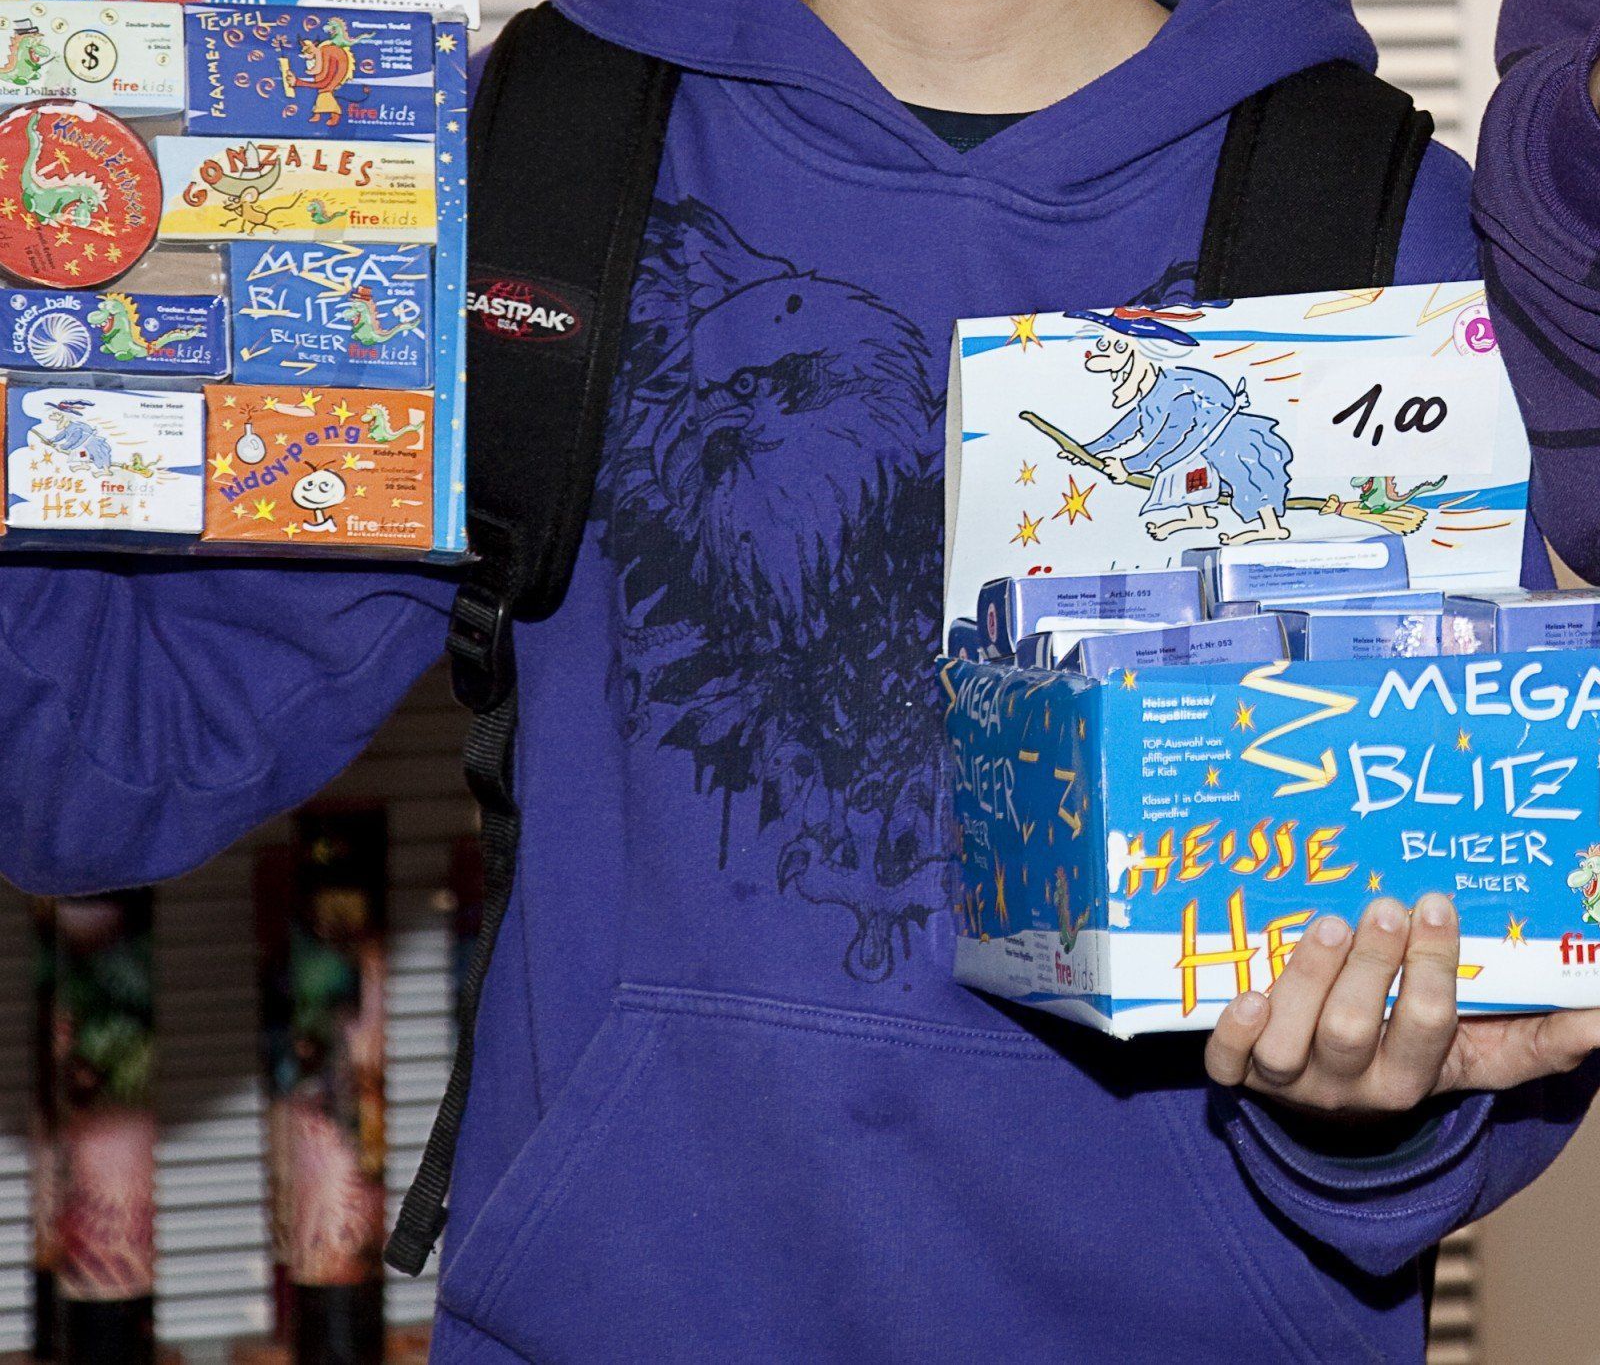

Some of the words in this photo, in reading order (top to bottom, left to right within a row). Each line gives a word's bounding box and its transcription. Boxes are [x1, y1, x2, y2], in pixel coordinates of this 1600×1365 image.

[196, 11, 277, 31] TEUFEL
[205, 37, 227, 118] FLAMMEN
[182, 143, 373, 208] GONZALES
[253, 251, 390, 286] MEGA
[1332, 383, 1449, 447] 1,00
[30, 476, 88, 493] HEISSE
[41, 492, 119, 521] HEXE
[1217, 639, 1233, 647] 053
[1142, 697, 1178, 709] Heisse
[1181, 694, 1216, 707] Hexe/
[1142, 709, 1209, 724] MegaBlitzer
[1142, 736, 1203, 749] TOP-Auswahl
[1206, 739, 1222, 747] von
[1142, 752, 1182, 766] pfiffigem
[1184, 749, 1231, 762] Feuerwerk
[1142, 767, 1155, 777] für
[1157, 766, 1177, 777] Kids
[1142, 795, 1171, 806] Klasse
[1182, 794, 1191, 803] in
[1193, 790, 1240, 803] Österreich
[1142, 807, 1189, 822] Jugendfrei
[1400, 829, 1553, 867] BLITZER
[1126, 818, 1359, 899] HEISSE
